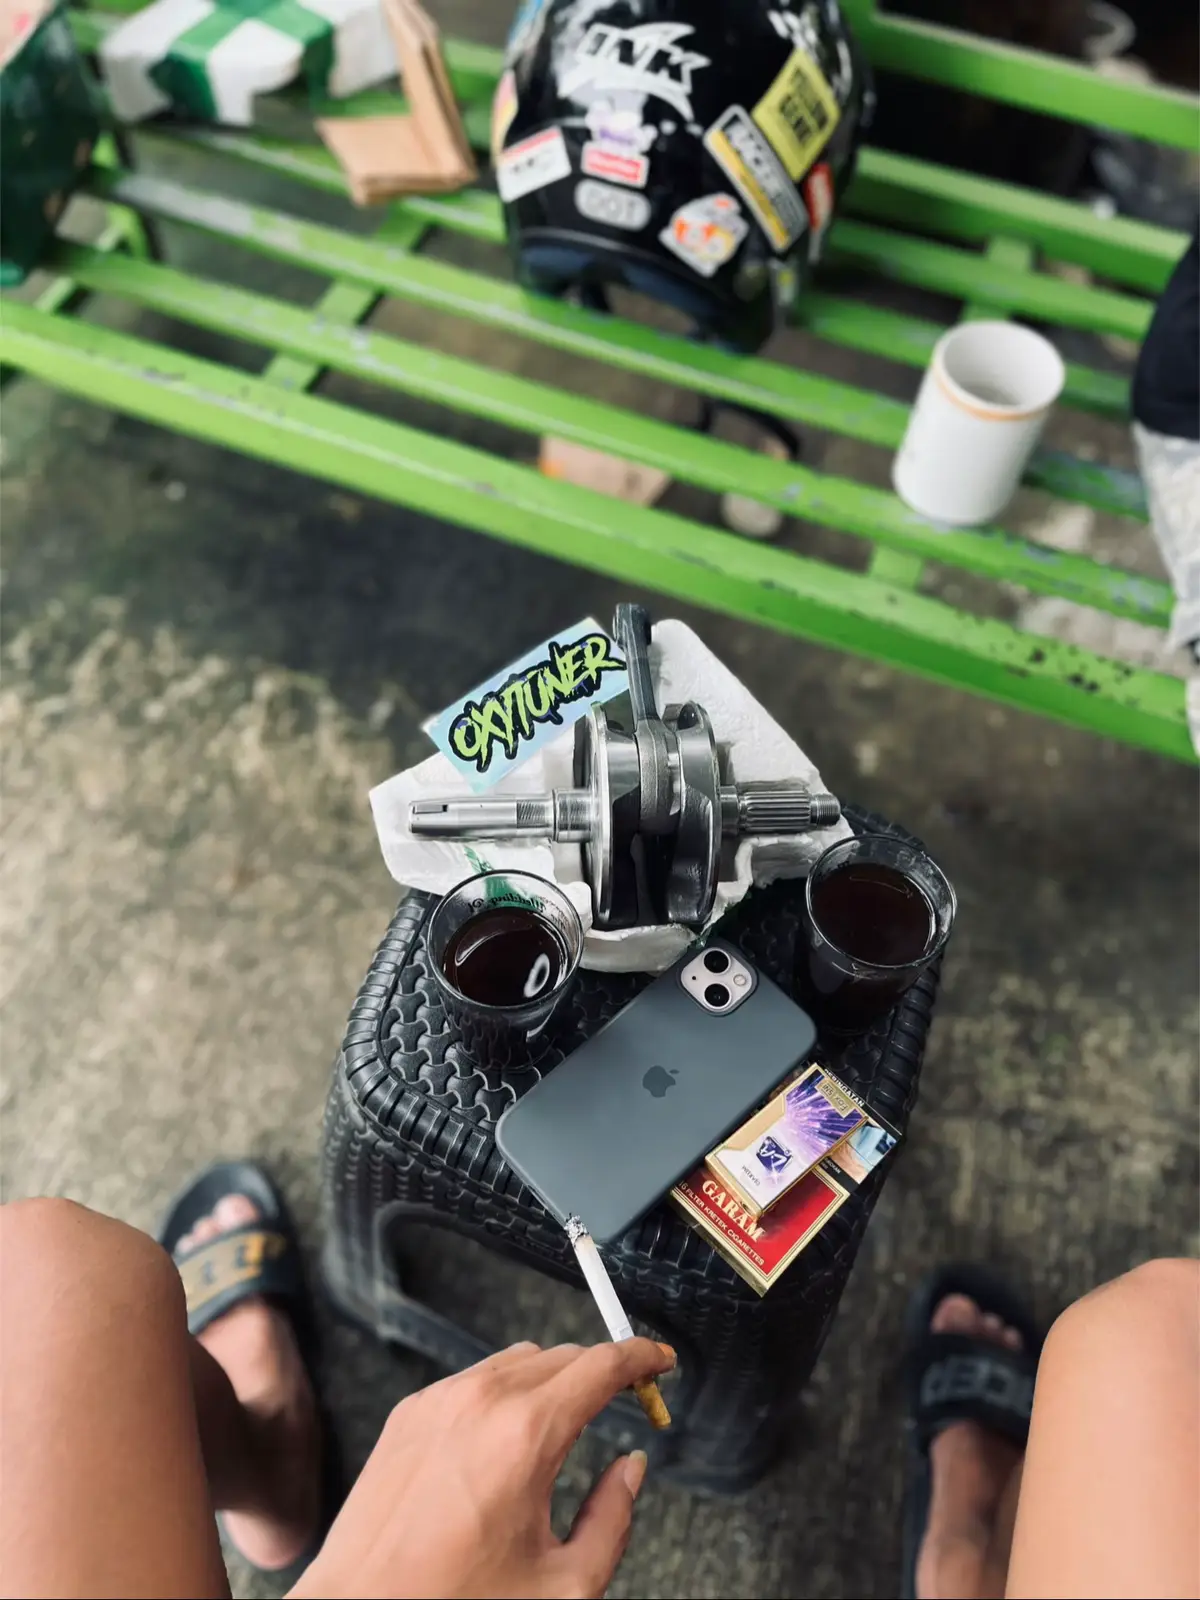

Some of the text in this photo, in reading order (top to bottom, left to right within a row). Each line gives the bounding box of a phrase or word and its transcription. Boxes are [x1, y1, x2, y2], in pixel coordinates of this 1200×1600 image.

[449, 633, 627, 772] OXYTUNER
[686, 1188, 705, 1208] FILTER
[703, 1206, 728, 1230] KRETEK
[727, 1229, 765, 1266] CIGARETTES
[702, 1180, 765, 1242] GARAM
